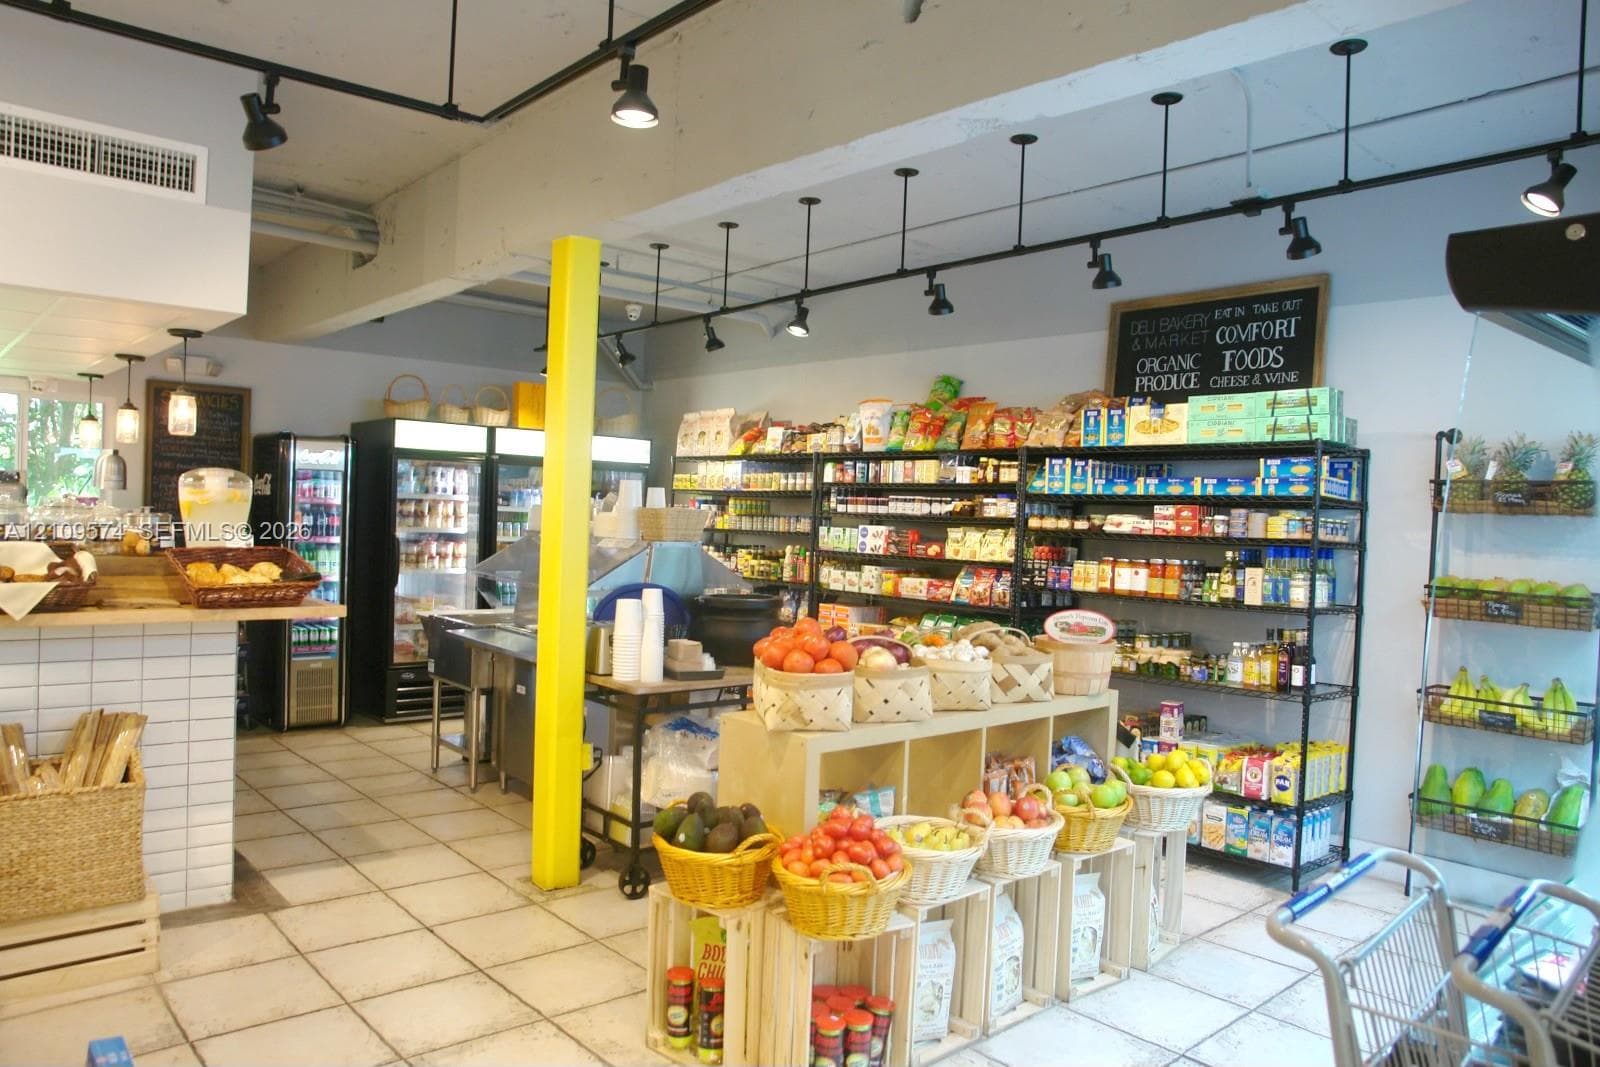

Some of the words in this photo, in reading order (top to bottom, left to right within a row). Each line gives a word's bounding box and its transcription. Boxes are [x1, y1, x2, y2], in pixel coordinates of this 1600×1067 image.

[1215, 307, 1232, 319] EAT
[1234, 305, 1245, 317] IN
[1253, 302, 1279, 314] TAKE
[1282, 299, 1303, 311] OUT
[1130, 320, 1155, 335] DELI
[1160, 312, 1211, 332] BAKERY
[1216, 316, 1301, 344] COMFORT
[1132, 338, 1141, 351] &
[1145, 330, 1210, 350] MARKET
[1136, 353, 1201, 374] ORGANIC
[1221, 345, 1284, 372] FOODS
[1135, 372, 1200, 392] PRODUCE
[1210, 374, 1250, 388] CHEESE
[1252, 373, 1261, 385] &
[1264, 371, 1299, 384] WINE
